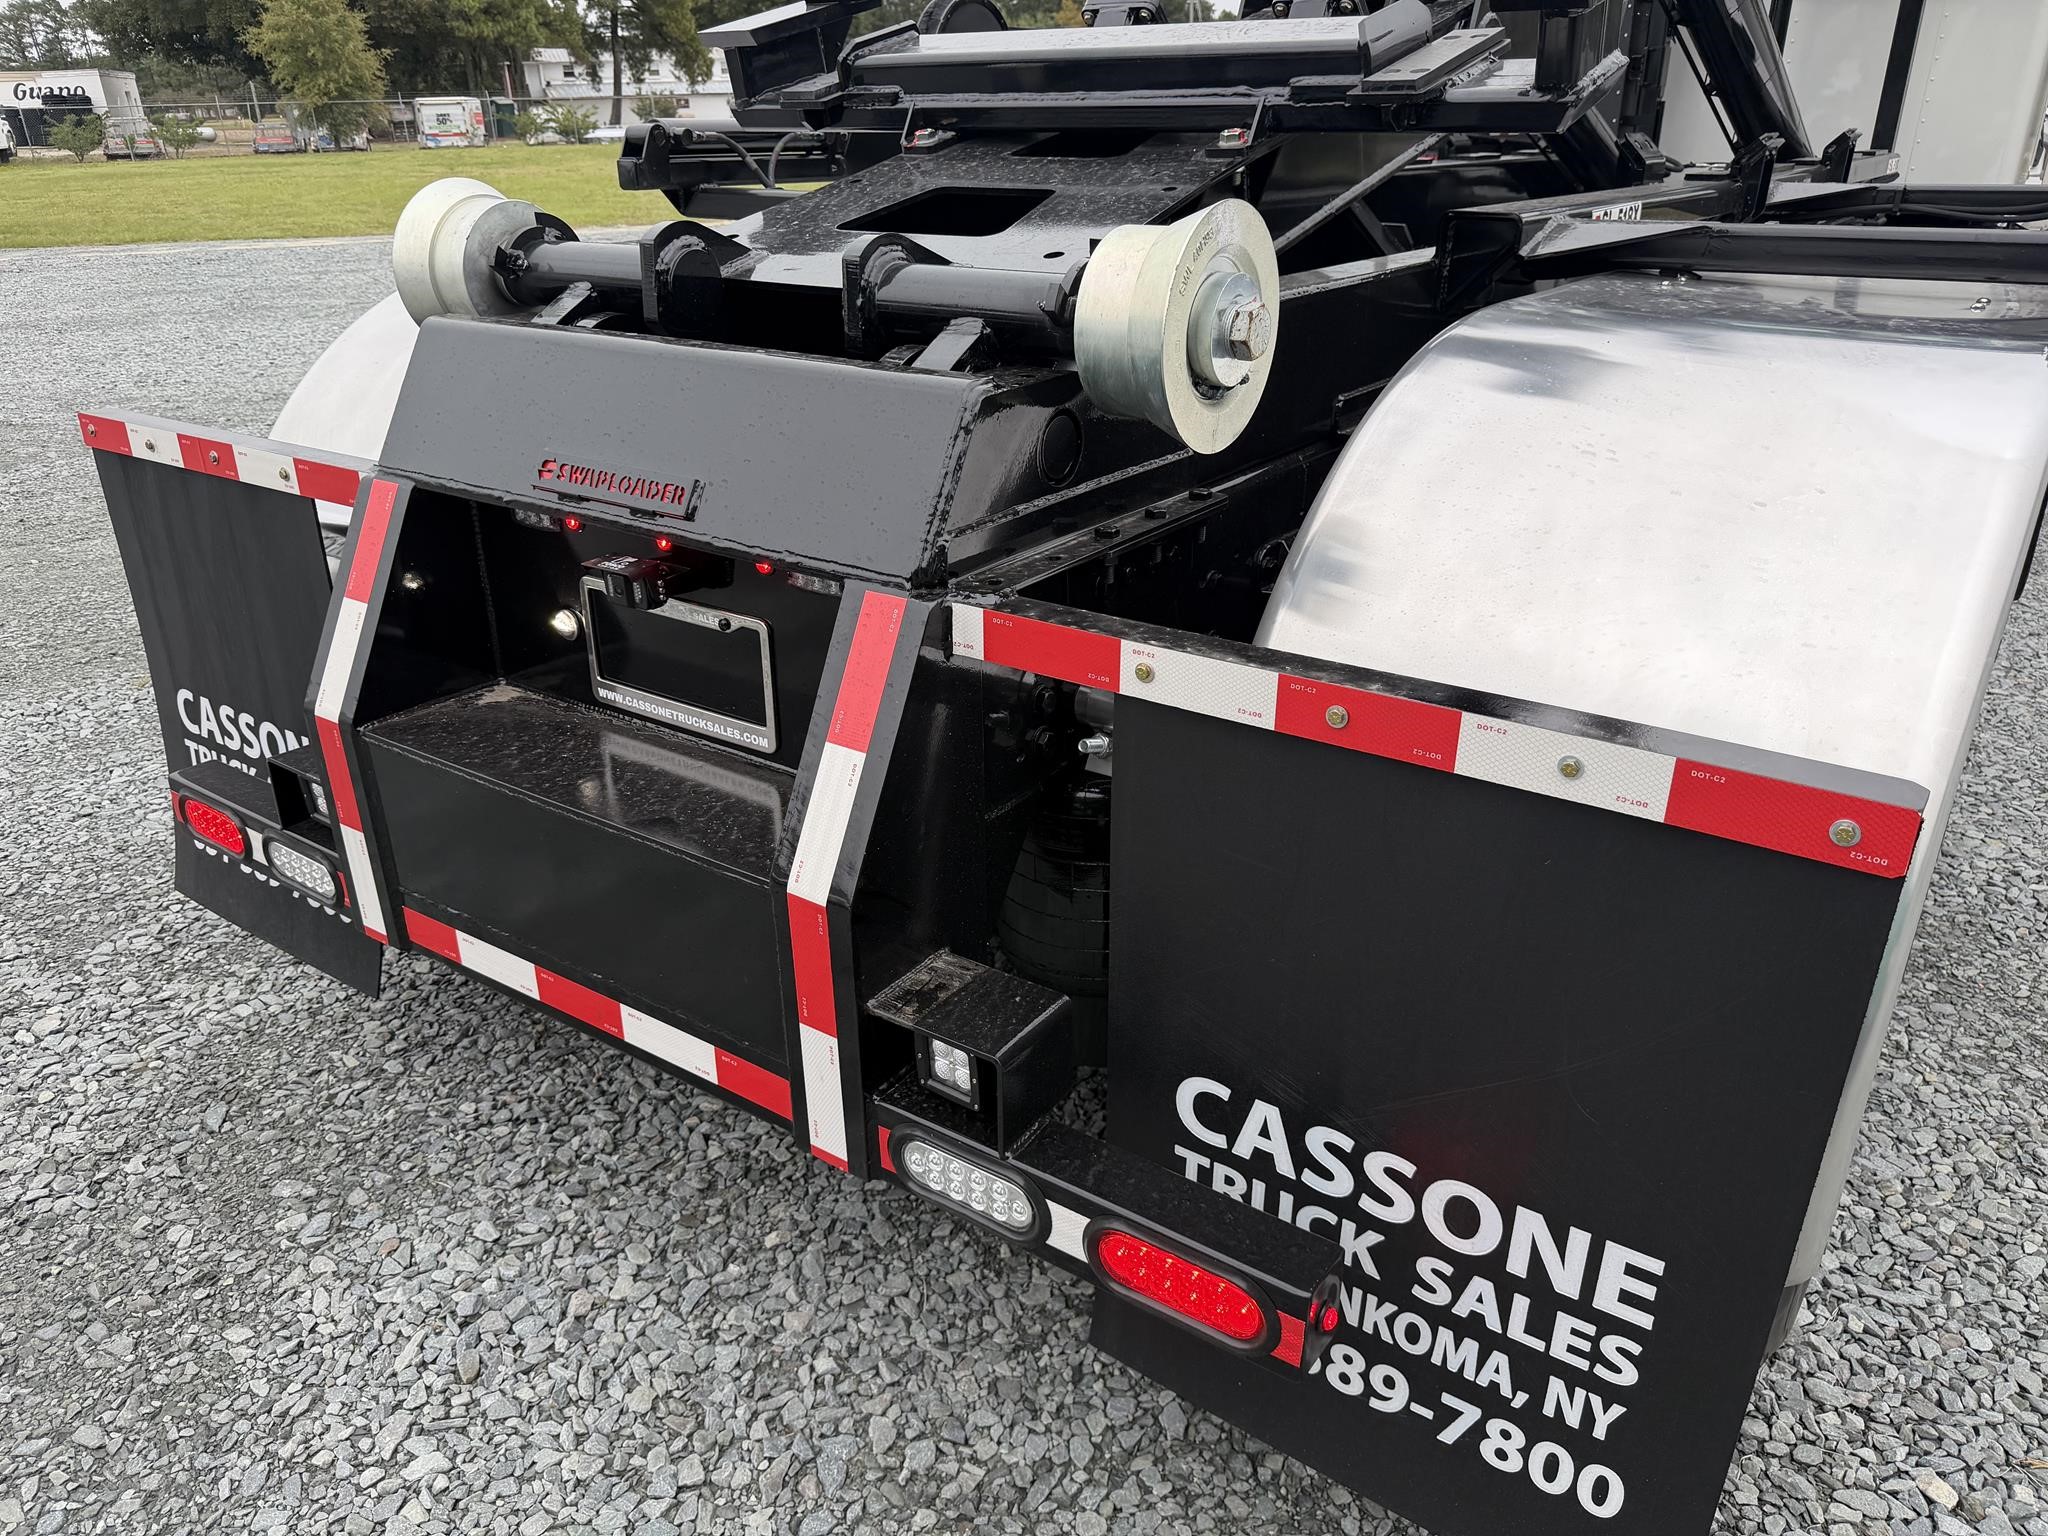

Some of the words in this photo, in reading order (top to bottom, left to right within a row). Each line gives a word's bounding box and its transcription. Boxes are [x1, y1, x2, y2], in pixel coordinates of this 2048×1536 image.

[13, 82, 86, 101] Guano
[1290, 683, 1317, 694] DOT-C2
[597, 687, 769, 748] WWW.CASSONETRUCKSALES.COM
[1237, 707, 1262, 719] DOT-C2
[1476, 723, 1508, 735] DOT-C2
[1412, 748, 1442, 760] DOT-C2
[1690, 769, 1726, 784] DOT-C2
[1615, 795, 1649, 809] DOT-C2
[1849, 850, 1888, 866] DOT-C2
[1175, 1076, 1666, 1330] CASSONE
[1411, 1255, 1644, 1387] SALES
[1542, 1375, 1628, 1441] NY
[1308, 1343, 1625, 1519] 89-7800
